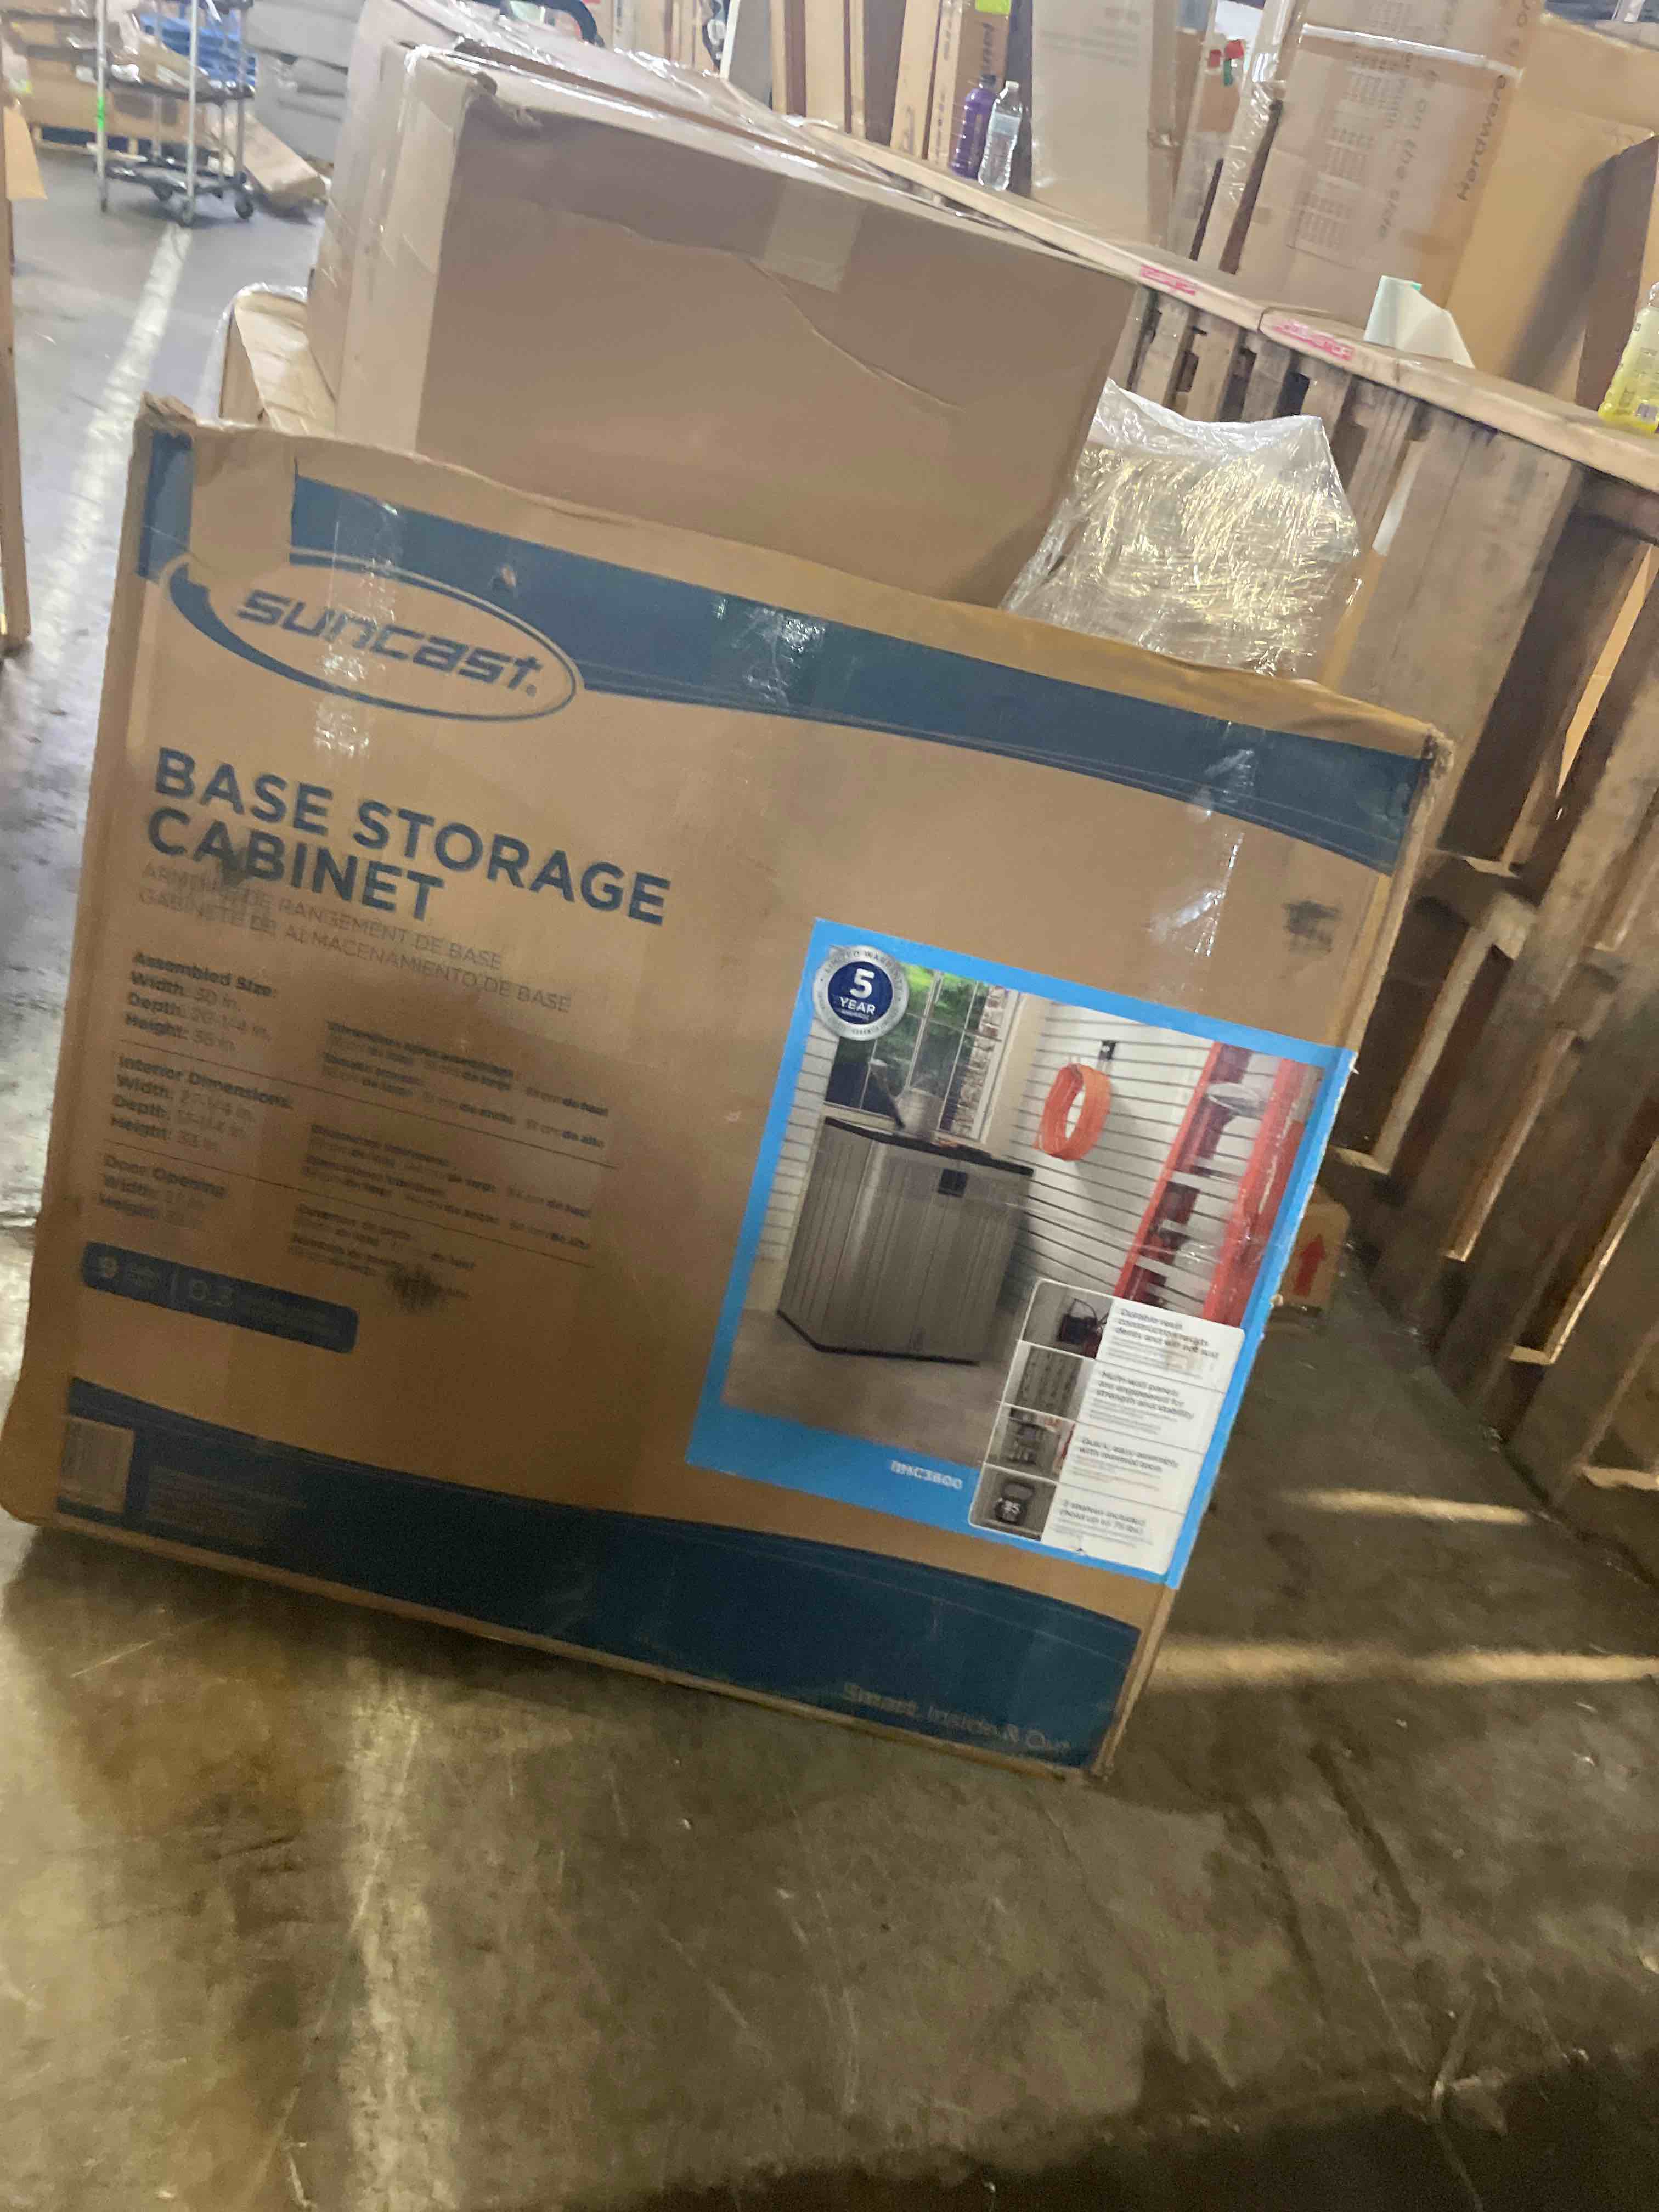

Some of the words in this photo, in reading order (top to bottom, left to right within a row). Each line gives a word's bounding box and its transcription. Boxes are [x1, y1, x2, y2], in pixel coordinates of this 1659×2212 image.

[1457, 75, 1506, 201] Hardware
[148, 806, 445, 921] CABINET
[155, 747, 333, 837] BASE
[352, 799, 671, 926] STORAGE
[278, 897, 408, 943] RANGEMENT
[414, 934, 443, 956] DE
[449, 941, 502, 970] BASE
[285, 924, 478, 988] ALMACENAMIENTO
[483, 977, 512, 997] DE
[517, 985, 572, 1013] BASE
[839, 996, 876, 1015] YEAR
[850, 968, 875, 999] 5
